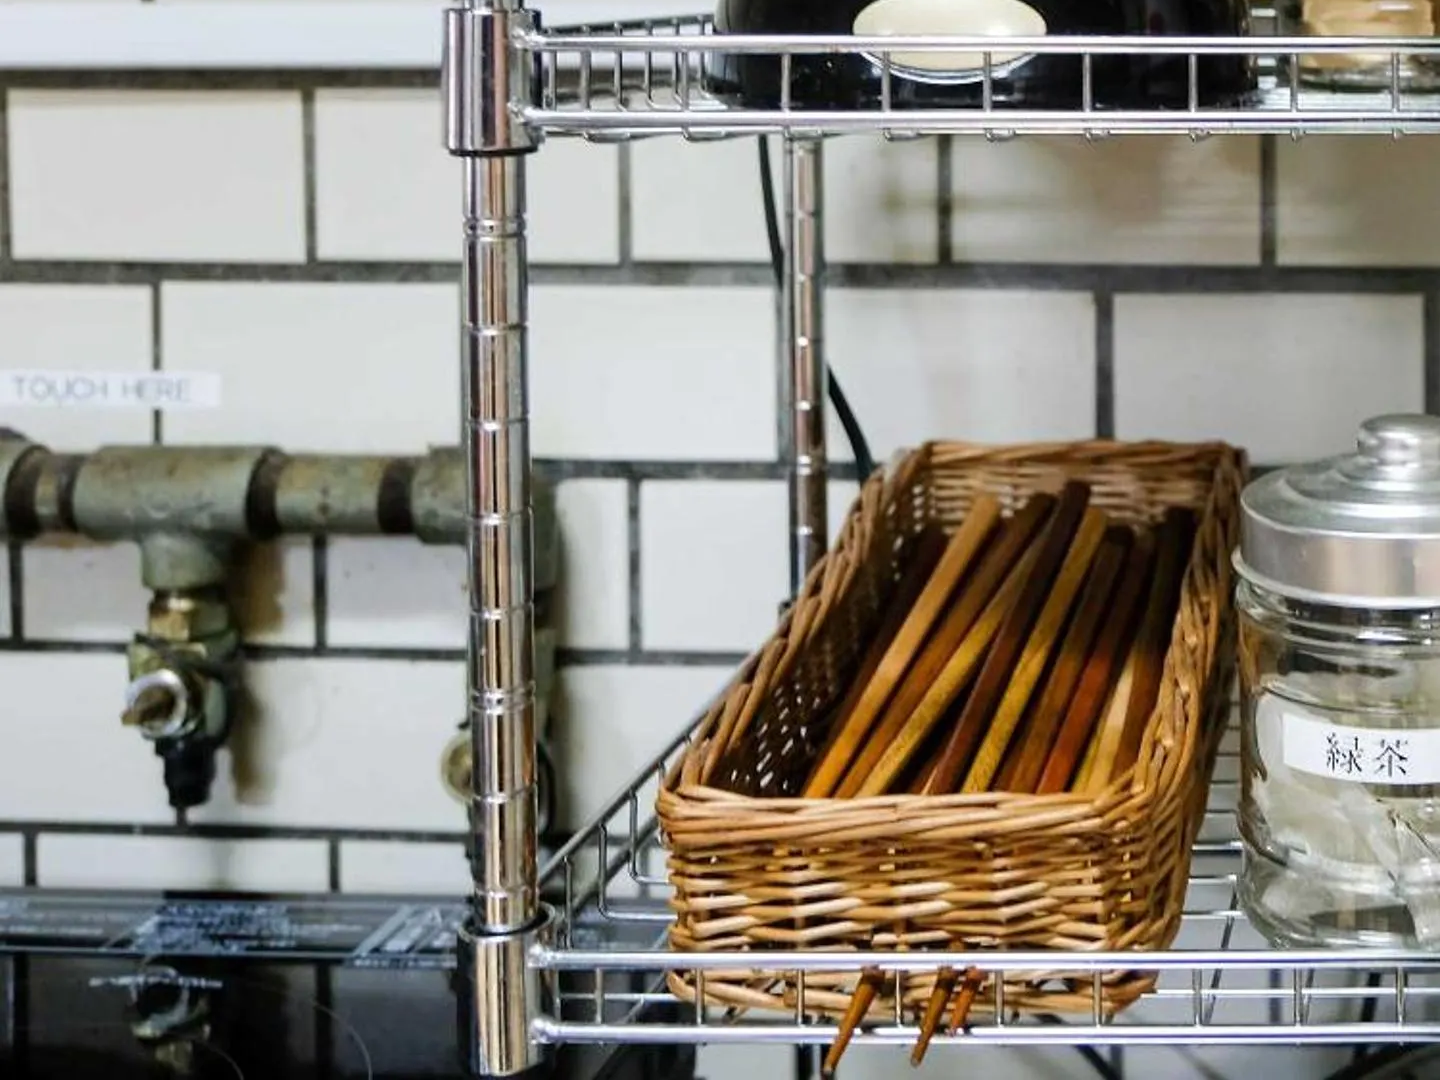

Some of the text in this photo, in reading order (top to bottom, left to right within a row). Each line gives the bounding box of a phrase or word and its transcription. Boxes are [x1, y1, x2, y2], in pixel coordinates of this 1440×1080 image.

[13, 375, 192, 402] TOUCH HERE
[1326, 731, 1408, 777] 緑茶
